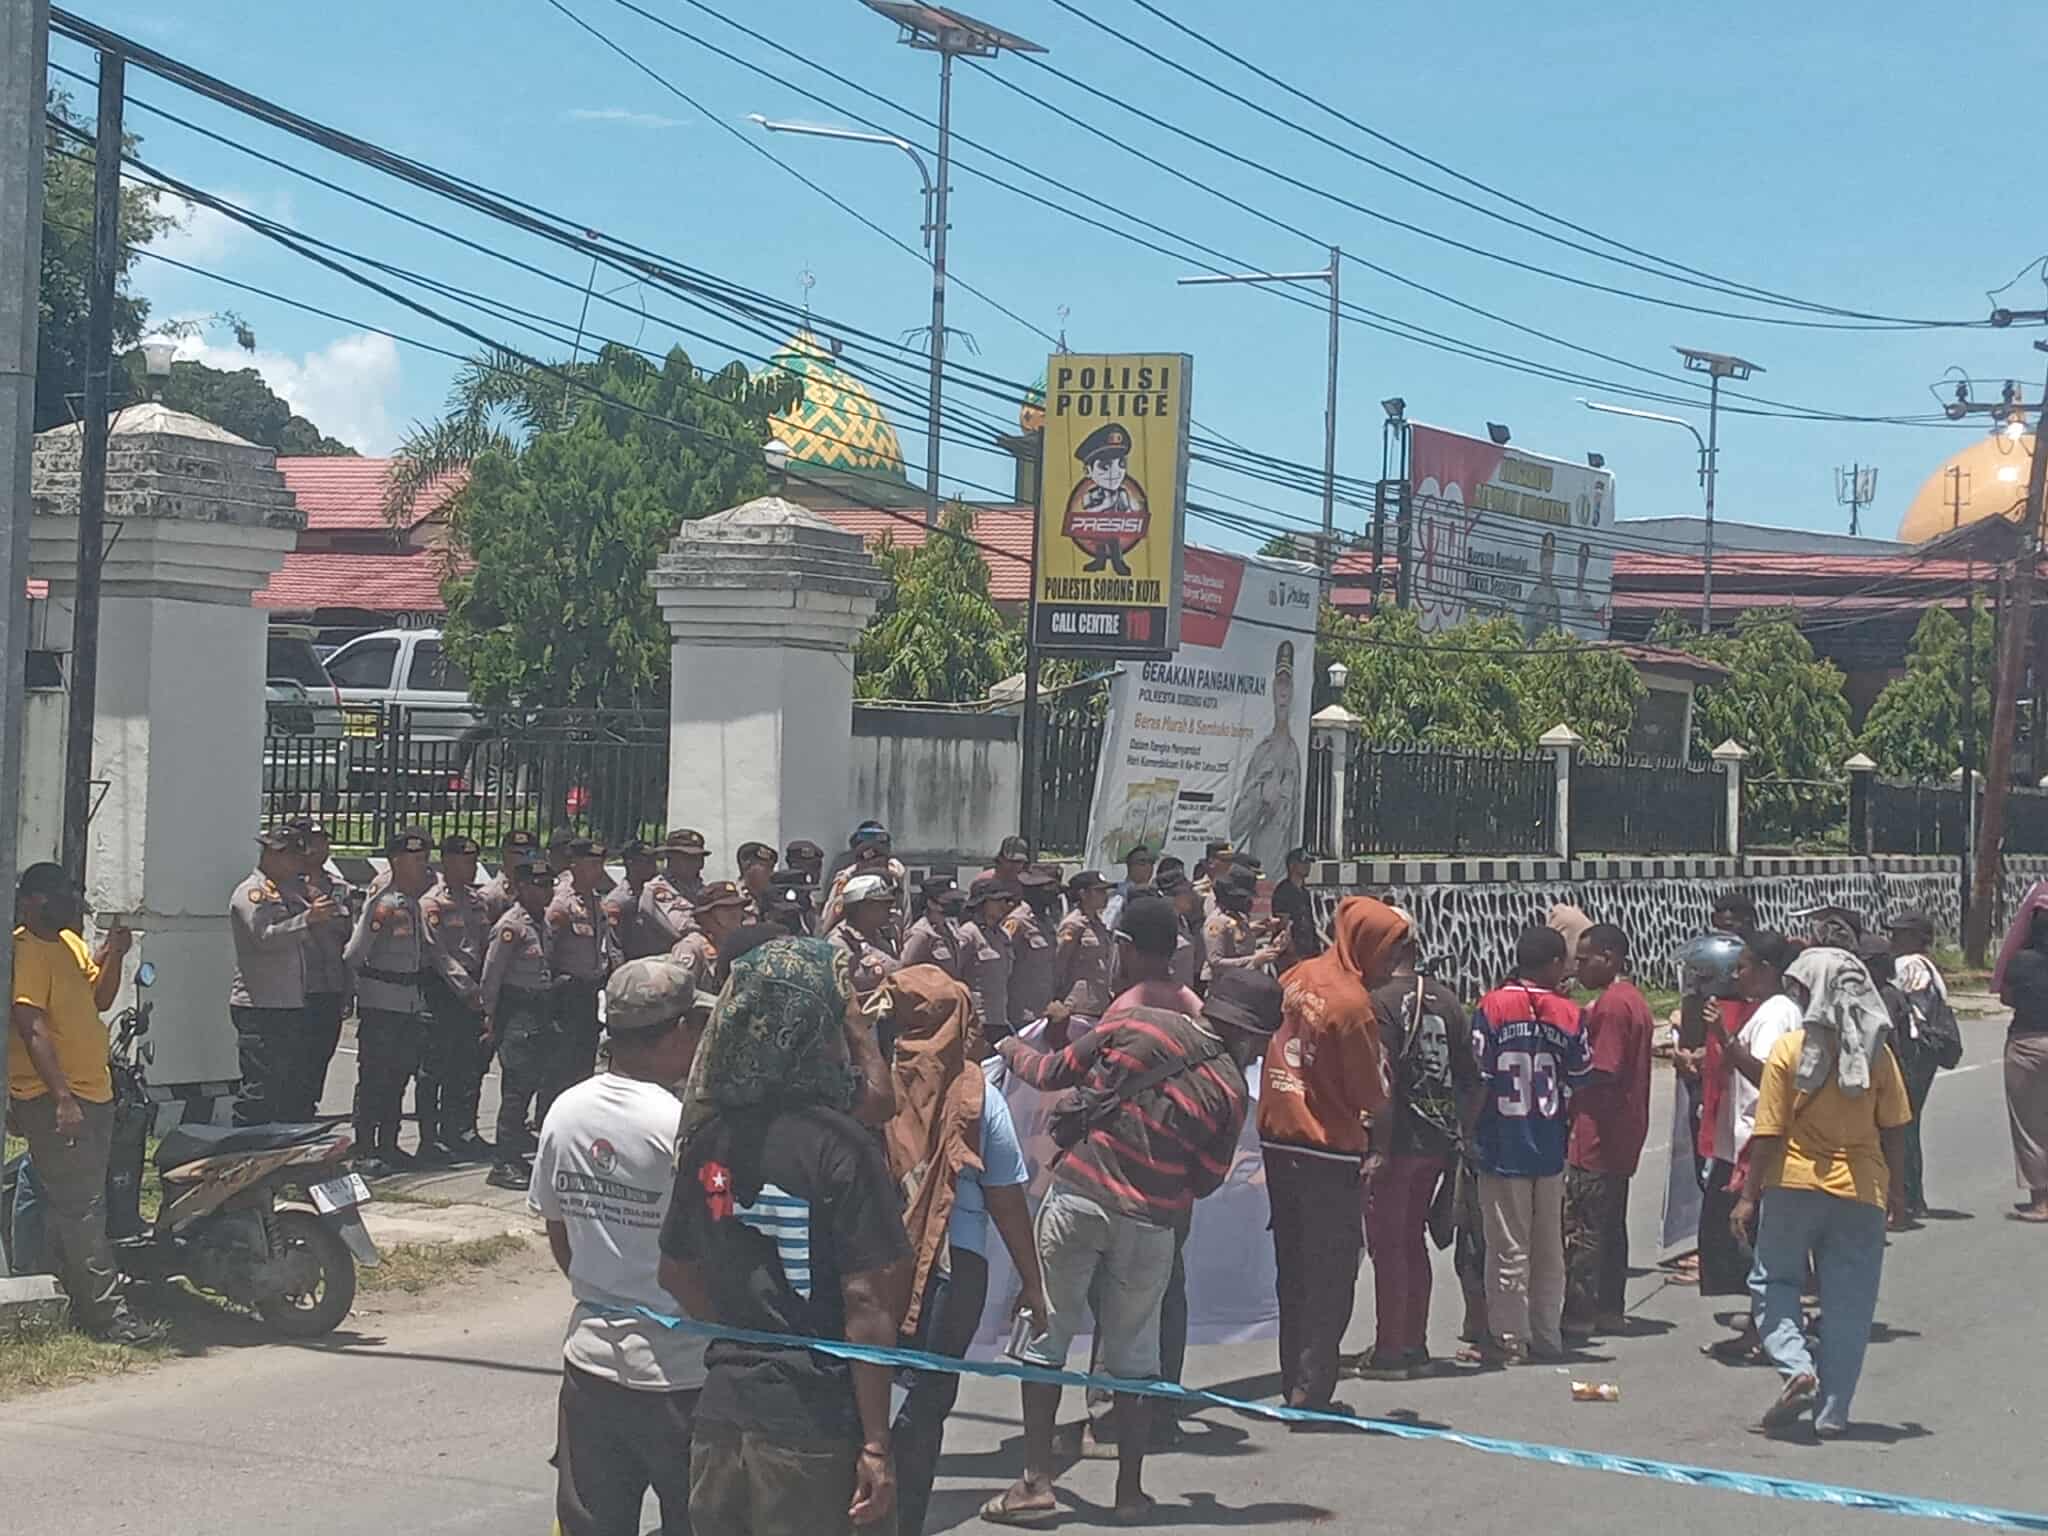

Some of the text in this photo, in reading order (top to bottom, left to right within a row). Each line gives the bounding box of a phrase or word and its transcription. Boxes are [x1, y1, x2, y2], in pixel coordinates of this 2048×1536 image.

[1057, 367, 1169, 390] POLISI
[1056, 394, 1168, 417] POLICE
[1071, 516, 1144, 533] PRESISI
[1044, 577, 1091, 601] POLRESTA
[1092, 577, 1134, 602] SORONG
[1135, 579, 1161, 602] KOTA
[1051, 611, 1077, 633] CALL
[1078, 613, 1120, 635] CENTRE
[1141, 661, 1197, 689] GERAKAN
[1196, 668, 1237, 693] PANGAN
[1138, 688, 1175, 704] POLRESTA
